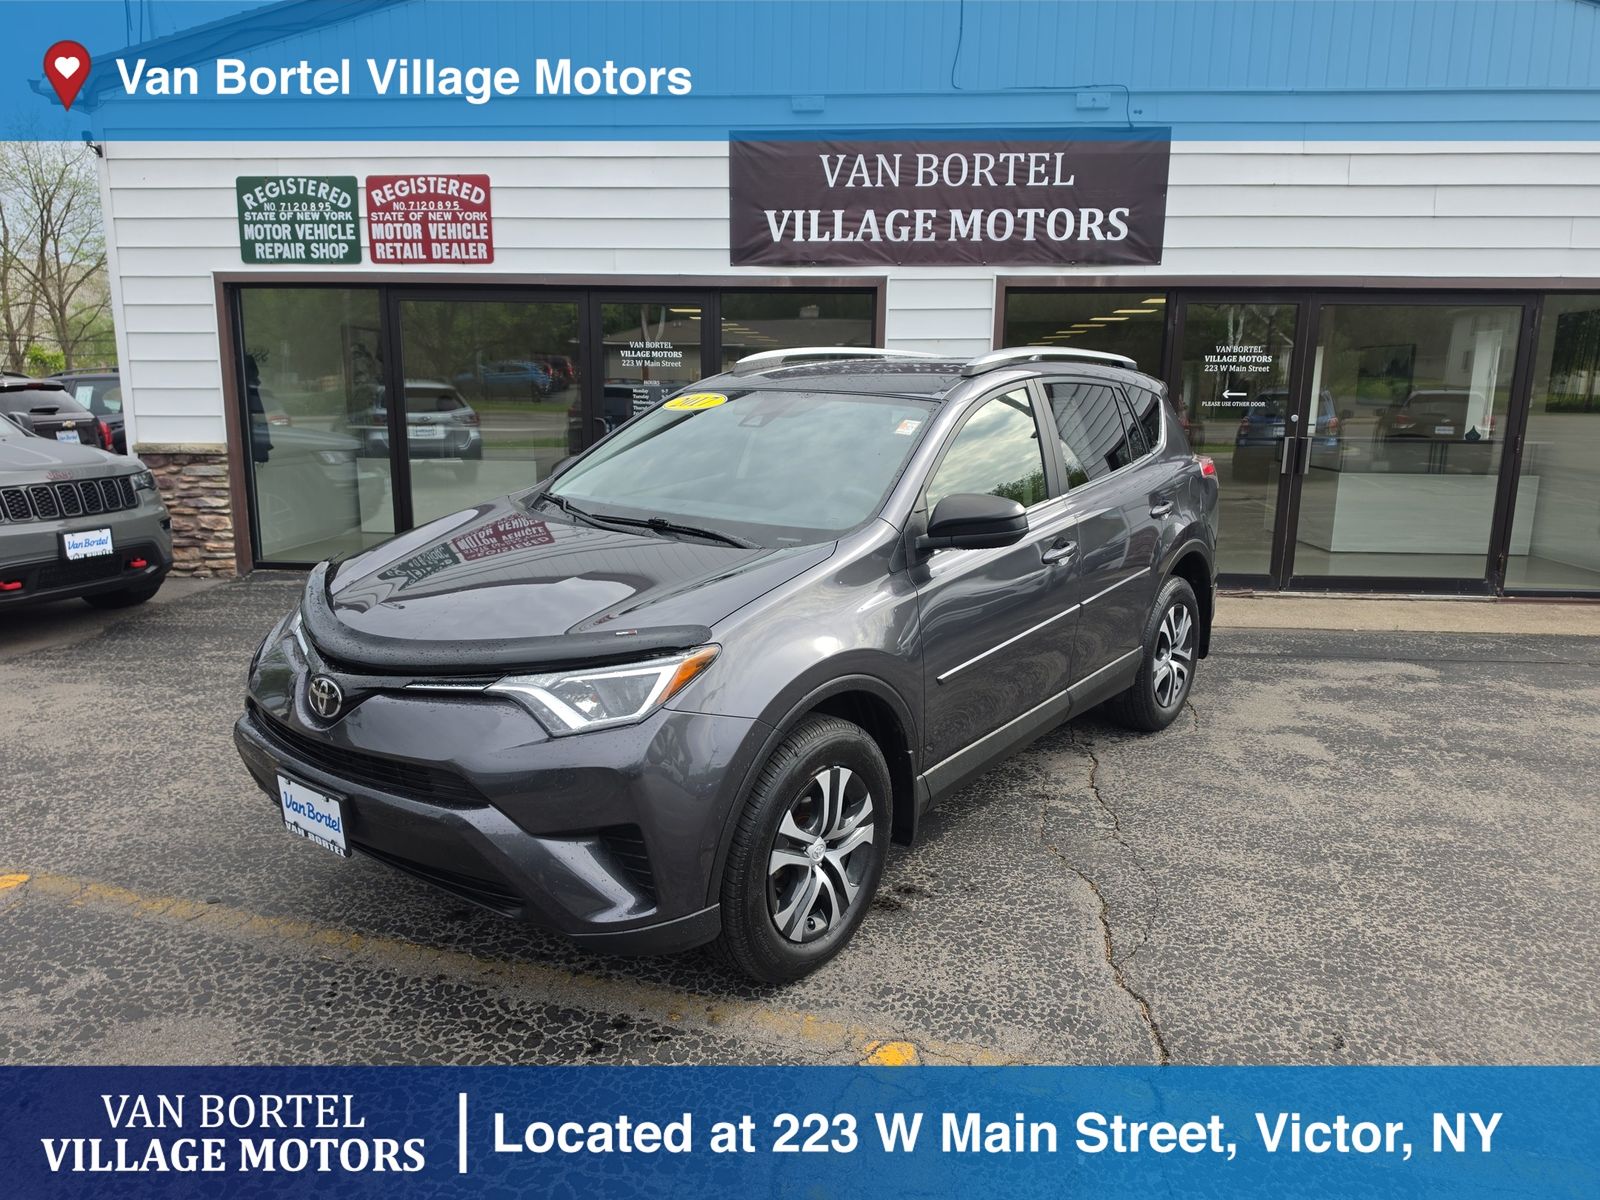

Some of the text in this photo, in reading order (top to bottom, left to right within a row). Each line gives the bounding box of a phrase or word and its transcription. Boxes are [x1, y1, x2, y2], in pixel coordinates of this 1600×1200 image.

[819, 152, 1075, 188] VAN BORTEL
[242, 177, 352, 210] REGISTERED
[371, 176, 486, 207] REGISTERED
[280, 202, 331, 211] 7120895
[408, 200, 460, 210] 7120895
[244, 211, 353, 221] STATE OF NEW YORK
[370, 211, 488, 221] STATE OF NEW YORK
[763, 207, 1130, 242] VILLAGE MOTORS
[243, 223, 356, 240] MOTOR VEHICLE
[371, 223, 489, 240] MOTOR VEHICLE
[255, 242, 349, 259] REPAIR SHOP
[375, 242, 488, 259] RETAIL DEALER
[629, 341, 673, 349] VAN BORTEL
[1216, 345, 1263, 353] VAN BORTEL
[651, 350, 683, 358] MOTORS
[1204, 355, 1273, 363] VILLAGE MOTORS
[622, 359, 634, 367] 223
[1204, 364, 1218, 372] 223
[1219, 364, 1228, 372] W
[1248, 364, 1270, 372] Street
[68, 536, 109, 550] Van Bortel
[283, 791, 341, 833] Van Bortel
